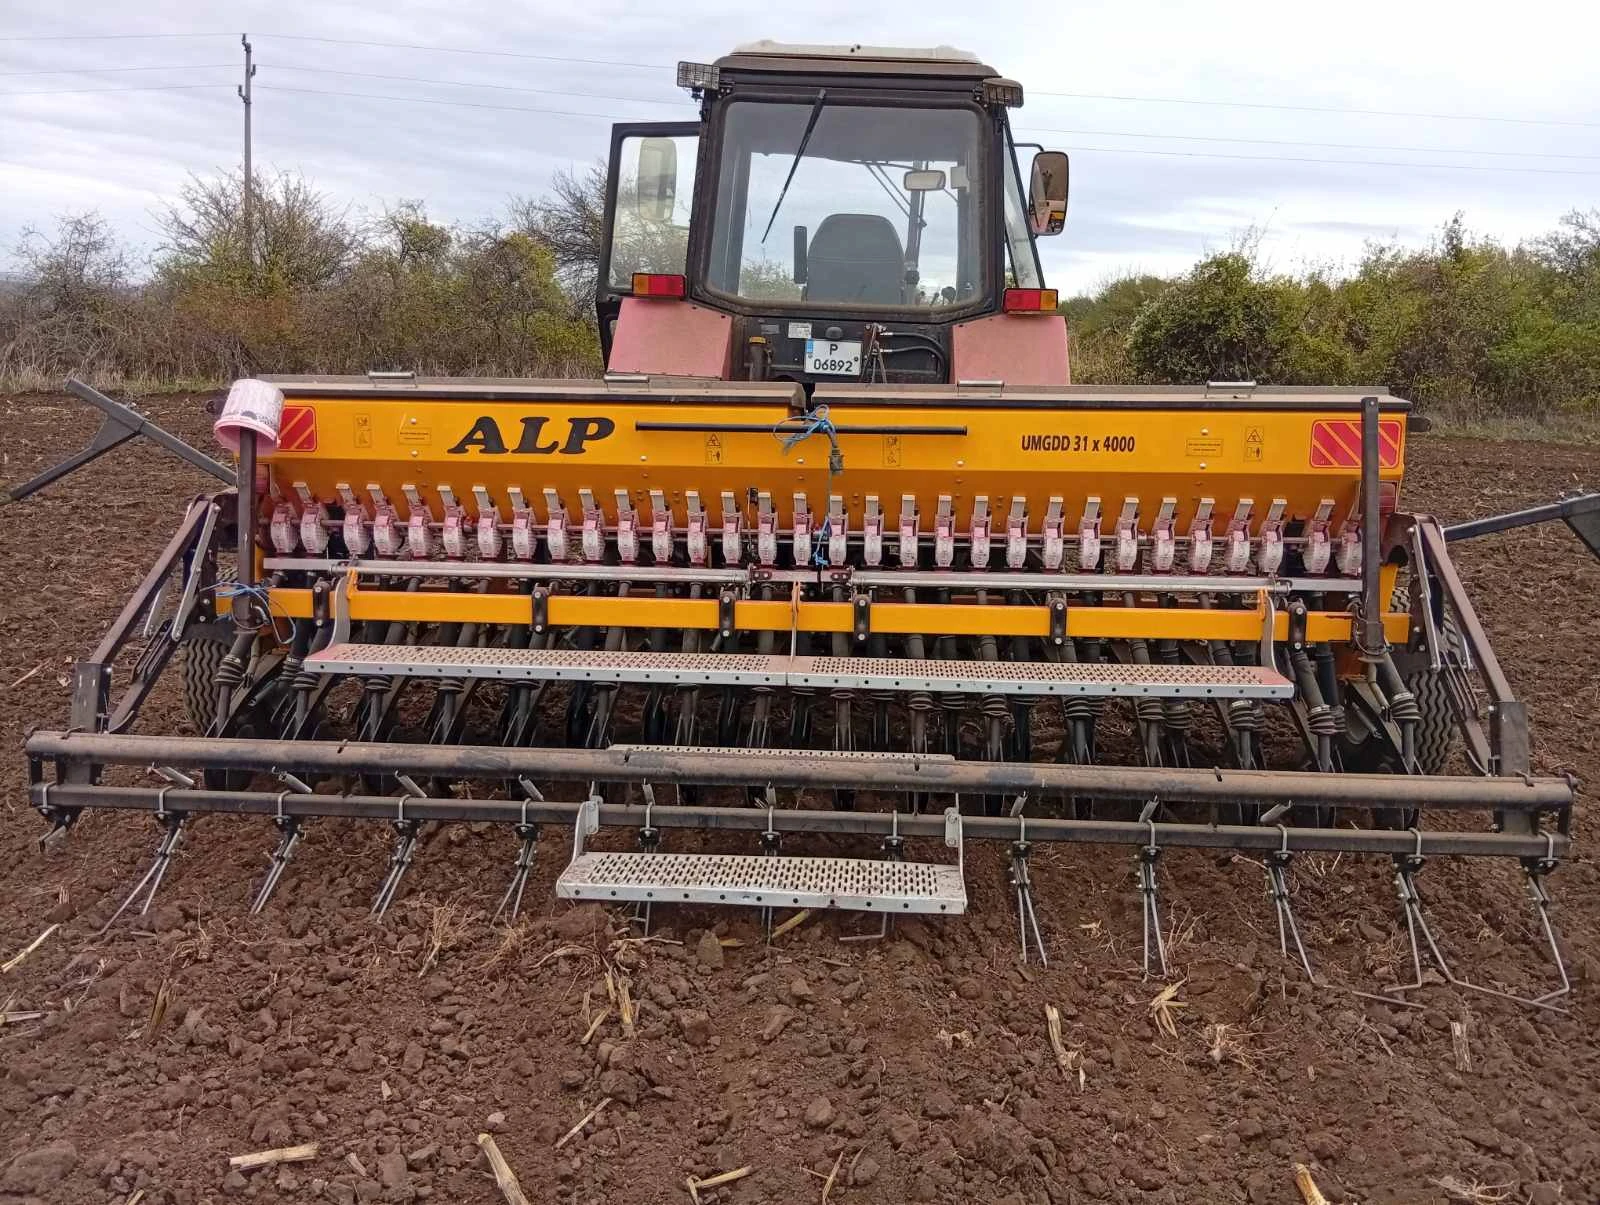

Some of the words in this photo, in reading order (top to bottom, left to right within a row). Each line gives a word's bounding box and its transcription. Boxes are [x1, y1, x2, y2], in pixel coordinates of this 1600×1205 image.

[829, 343, 839, 356] P
[813, 358, 853, 373] 06892
[446, 415, 616, 455] ALP
[1021, 434, 1071, 452] UMGDD
[1073, 435, 1089, 452] 31
[1091, 439, 1101, 452] x
[1103, 435, 1136, 453] 4000
